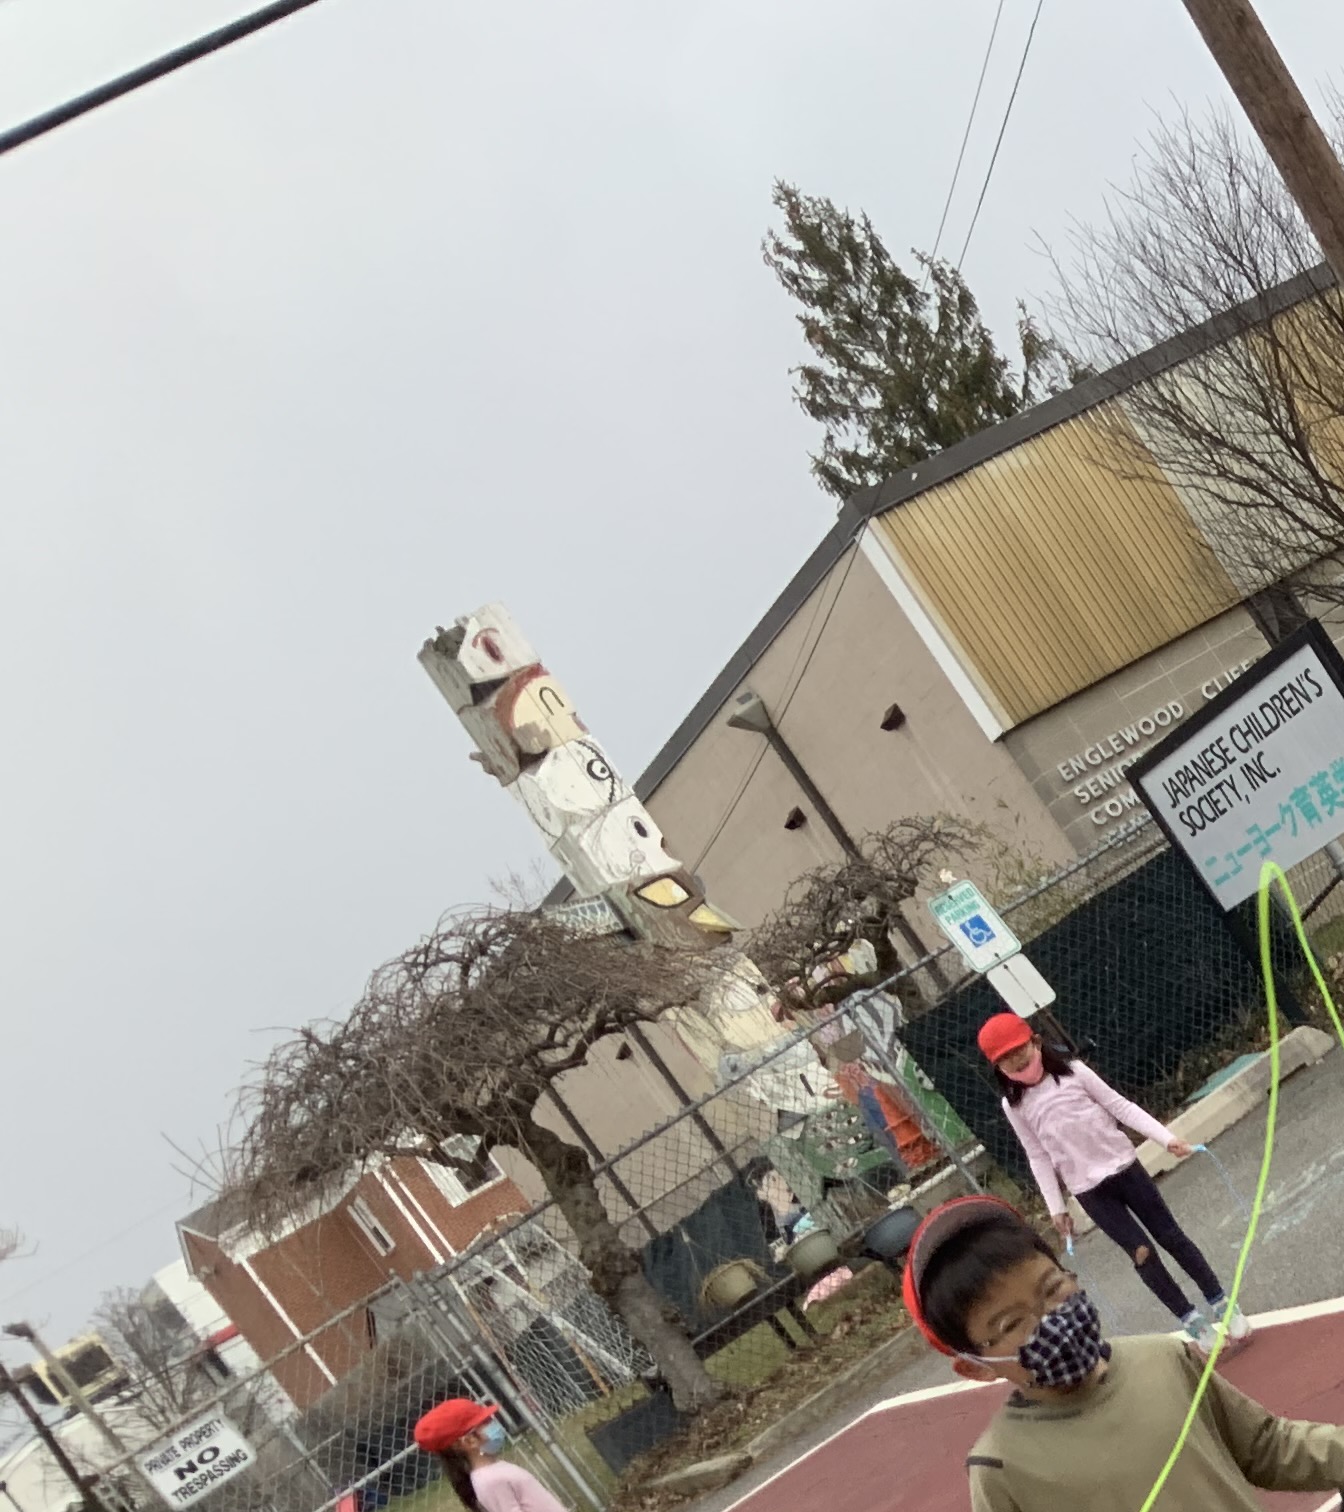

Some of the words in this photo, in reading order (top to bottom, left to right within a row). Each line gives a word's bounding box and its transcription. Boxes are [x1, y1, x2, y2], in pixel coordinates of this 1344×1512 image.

[1057, 701, 1184, 782] ENGLEWOOD
[1162, 736, 1237, 809] JAPANESE
[1229, 668, 1323, 754] CHILDREN'S
[1178, 775, 1251, 837] SOCIETY,
[1239, 751, 1281, 792] INC.
[144, 1446, 181, 1475] PRIVATE
[179, 1419, 225, 1452] PROPERTY
[171, 1449, 248, 1502] TRESPASSING
[174, 1446, 220, 1480] NO
